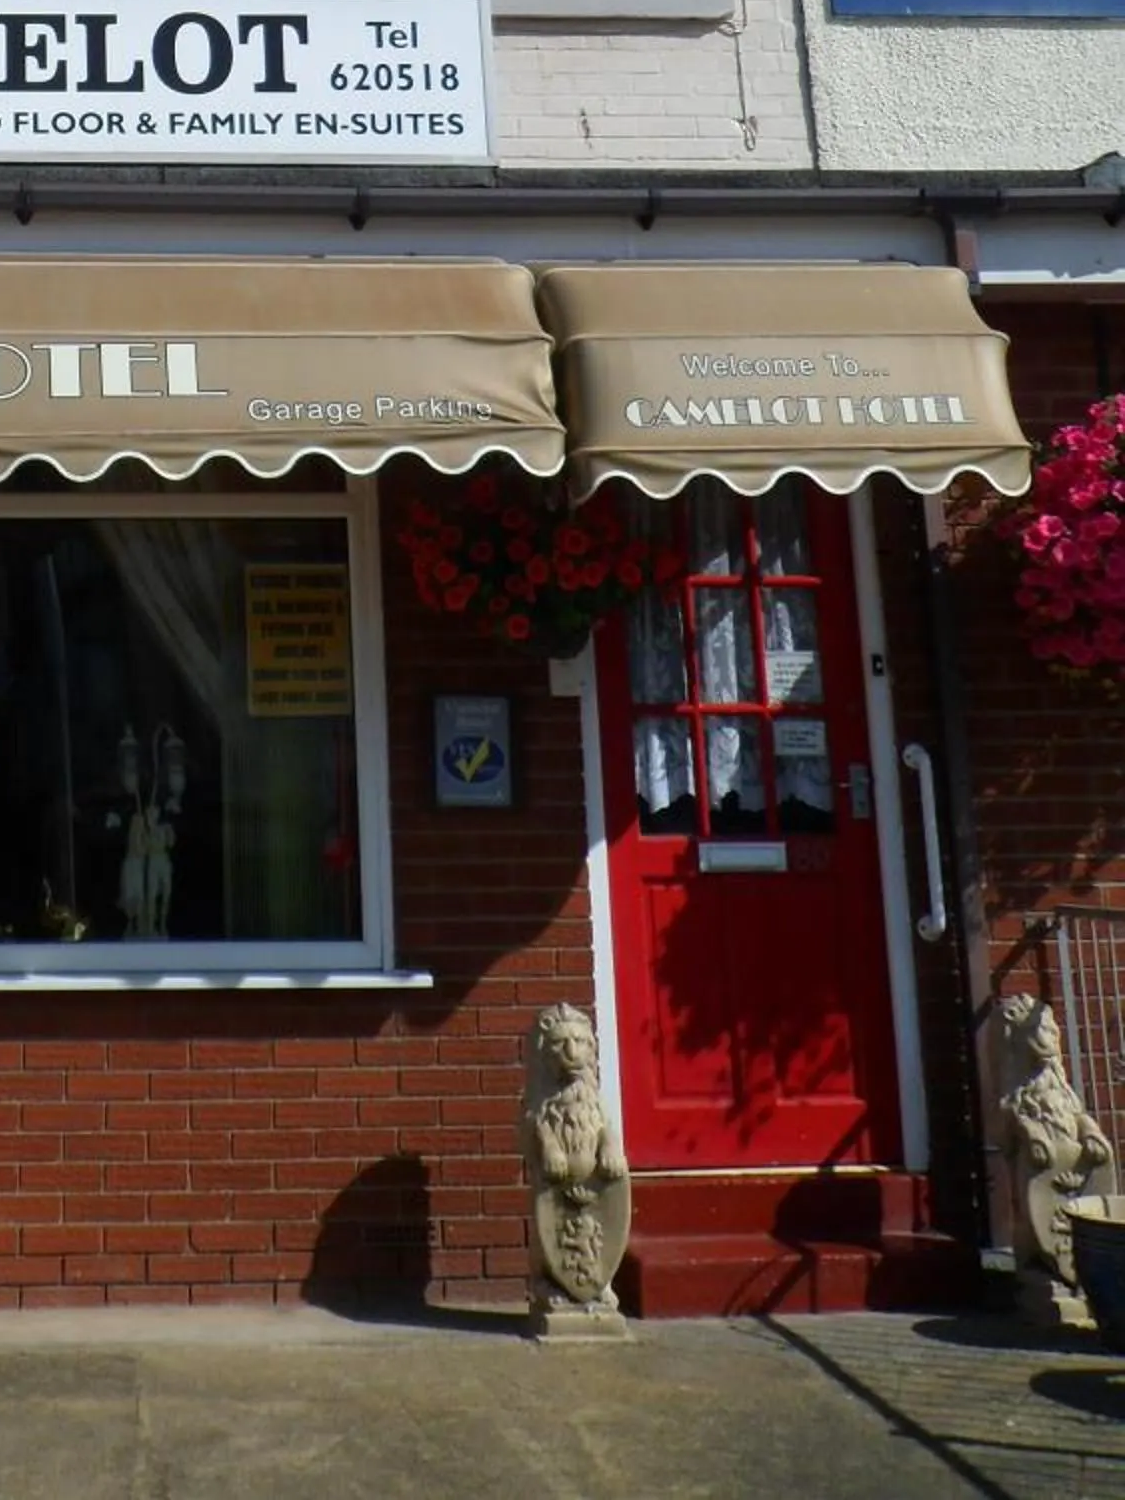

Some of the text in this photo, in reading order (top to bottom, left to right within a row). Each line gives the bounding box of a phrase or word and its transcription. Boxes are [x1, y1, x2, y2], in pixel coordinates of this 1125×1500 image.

[365, 21, 418, 49] Tel
[329, 62, 460, 92] 620518
[12, 111, 127, 136] FLOOR
[136, 112, 158, 136] &
[169, 112, 284, 136] FAMILY
[295, 112, 465, 137] EN-SUITES
[681, 353, 816, 378] Welcome
[247, 396, 493, 425] Garage Parking
[625, 394, 975, 428] CAMELOT HOTEL
